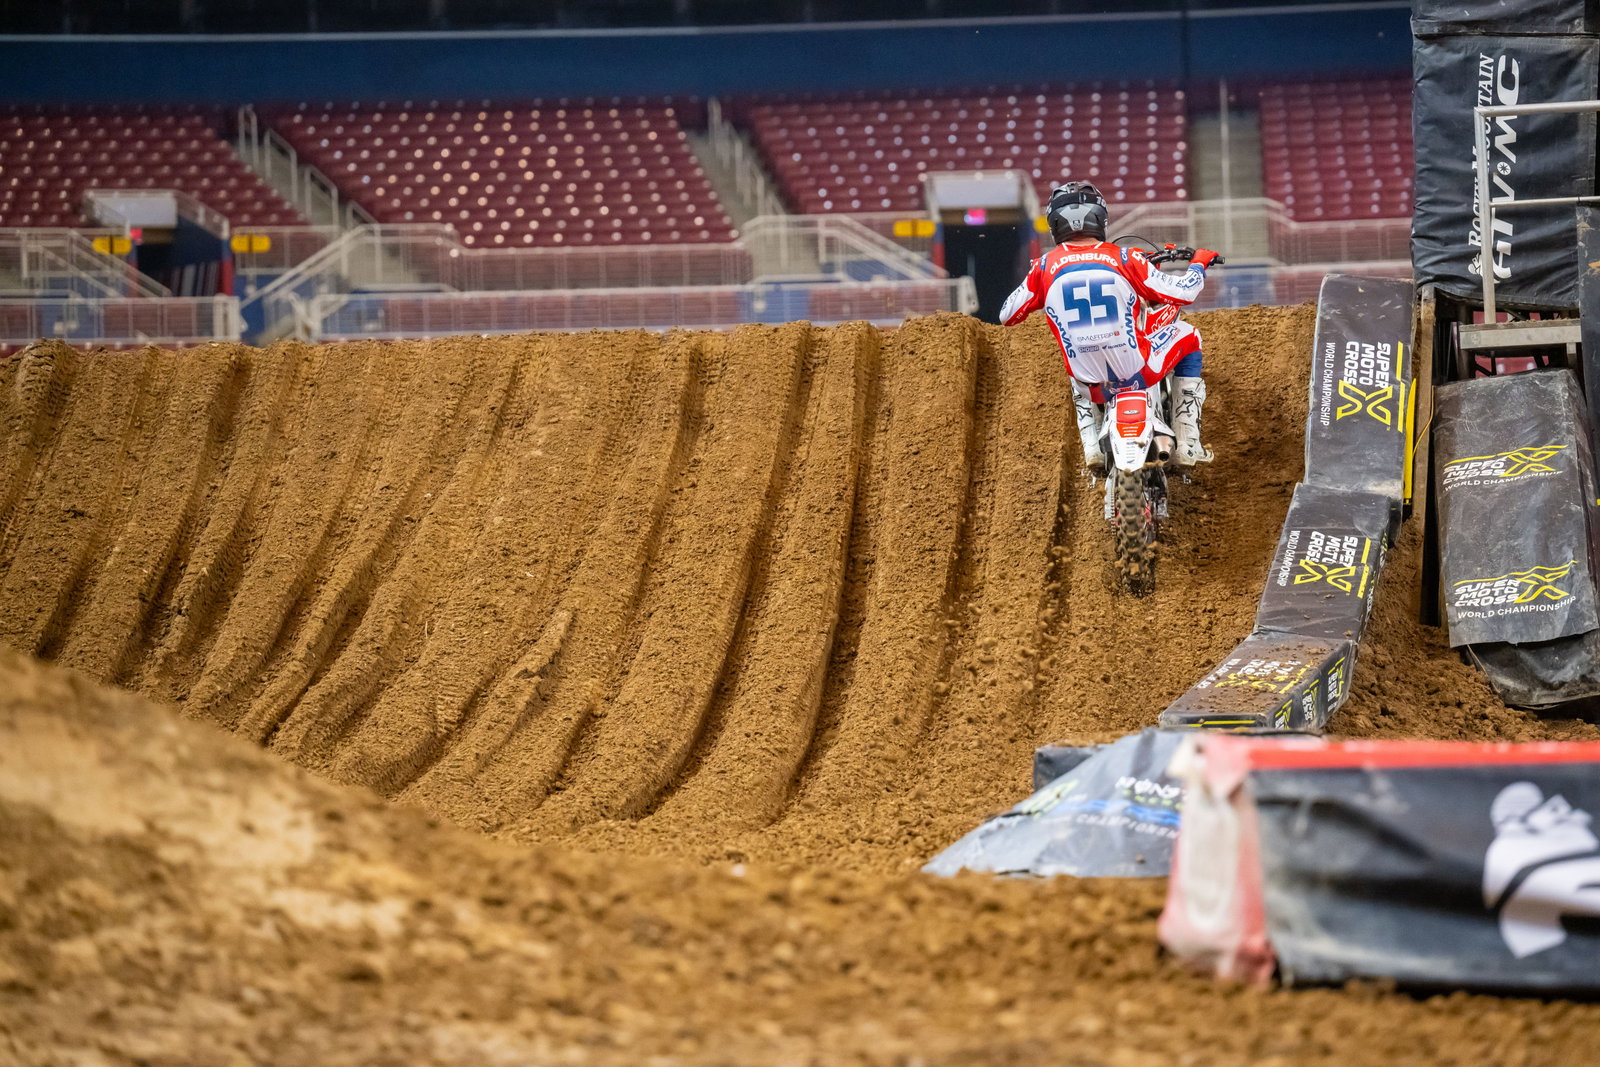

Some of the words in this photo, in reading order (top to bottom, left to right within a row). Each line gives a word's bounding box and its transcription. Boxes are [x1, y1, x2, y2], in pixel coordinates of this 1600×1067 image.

[1472, 53, 1494, 170] MTAIN
[1050, 252, 1118, 275] OLDENBURG
[1062, 278, 1119, 329] 55
[1046, 306, 1076, 359] CANVAS
[1325, 342, 1336, 369] WORLD
[1344, 341, 1359, 386] CROSS
[1359, 343, 1375, 386] MOTO
[1375, 342, 1391, 389] SUPER
[1320, 369, 1333, 426] CHAMPIONSHIP
[1454, 579, 1521, 595] SUPER
[1455, 593, 1520, 607] CROSS
[1457, 610, 1495, 619] WORLD
[1498, 595, 1576, 616] CHAMPIONSHIP
[1459, 586, 1518, 600] MOTO
